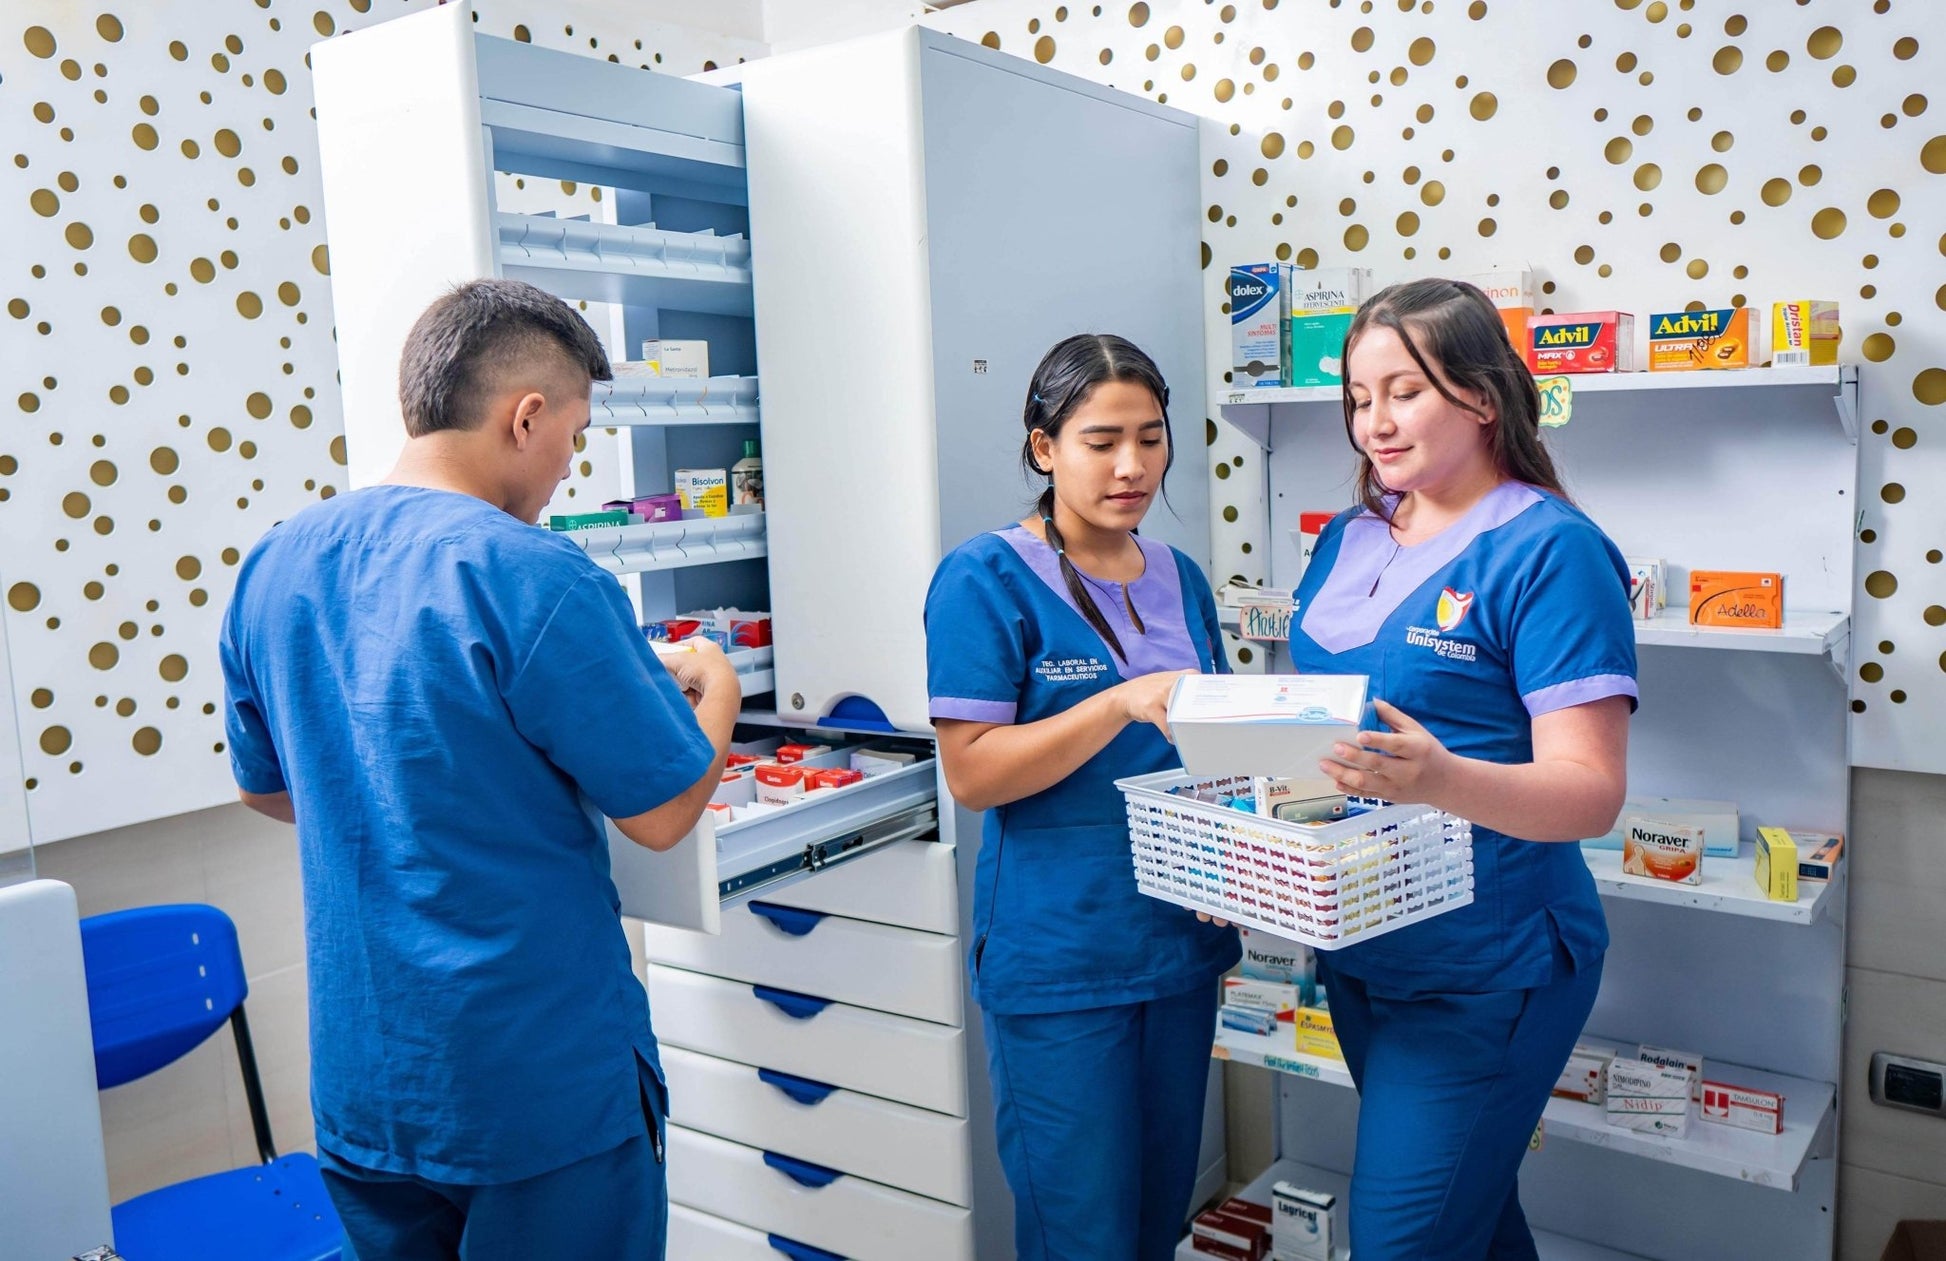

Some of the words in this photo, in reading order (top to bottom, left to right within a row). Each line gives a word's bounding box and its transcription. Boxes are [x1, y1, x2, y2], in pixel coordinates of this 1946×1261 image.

[1233, 284, 1264, 297] dolex
[1304, 290, 1345, 301] ASPIRINA
[1655, 312, 1719, 335] Advil
[1787, 304, 1803, 346] Dristan
[1538, 326, 1590, 345] Advil
[1654, 343, 1693, 352] ULTRA
[1537, 352, 1562, 360] MAX
[692, 477, 724, 486] Bisolvon
[1717, 603, 1767, 618] Adella
[1406, 632, 1476, 656] Unisystem
[1058, 659, 1087, 667] LABORAL
[1447, 651, 1476, 662] Colombia
[1076, 665, 1108, 673] SERVICIOS
[1046, 673, 1098, 681] FARMACEUTICOS
[1632, 827, 1689, 848] Noraver
[1659, 845, 1686, 854] GRIPA
[1248, 949, 1296, 967] Noraver
[1624, 1098, 1663, 1112] Nidip
[1278, 1201, 1317, 1222] Lagricel
